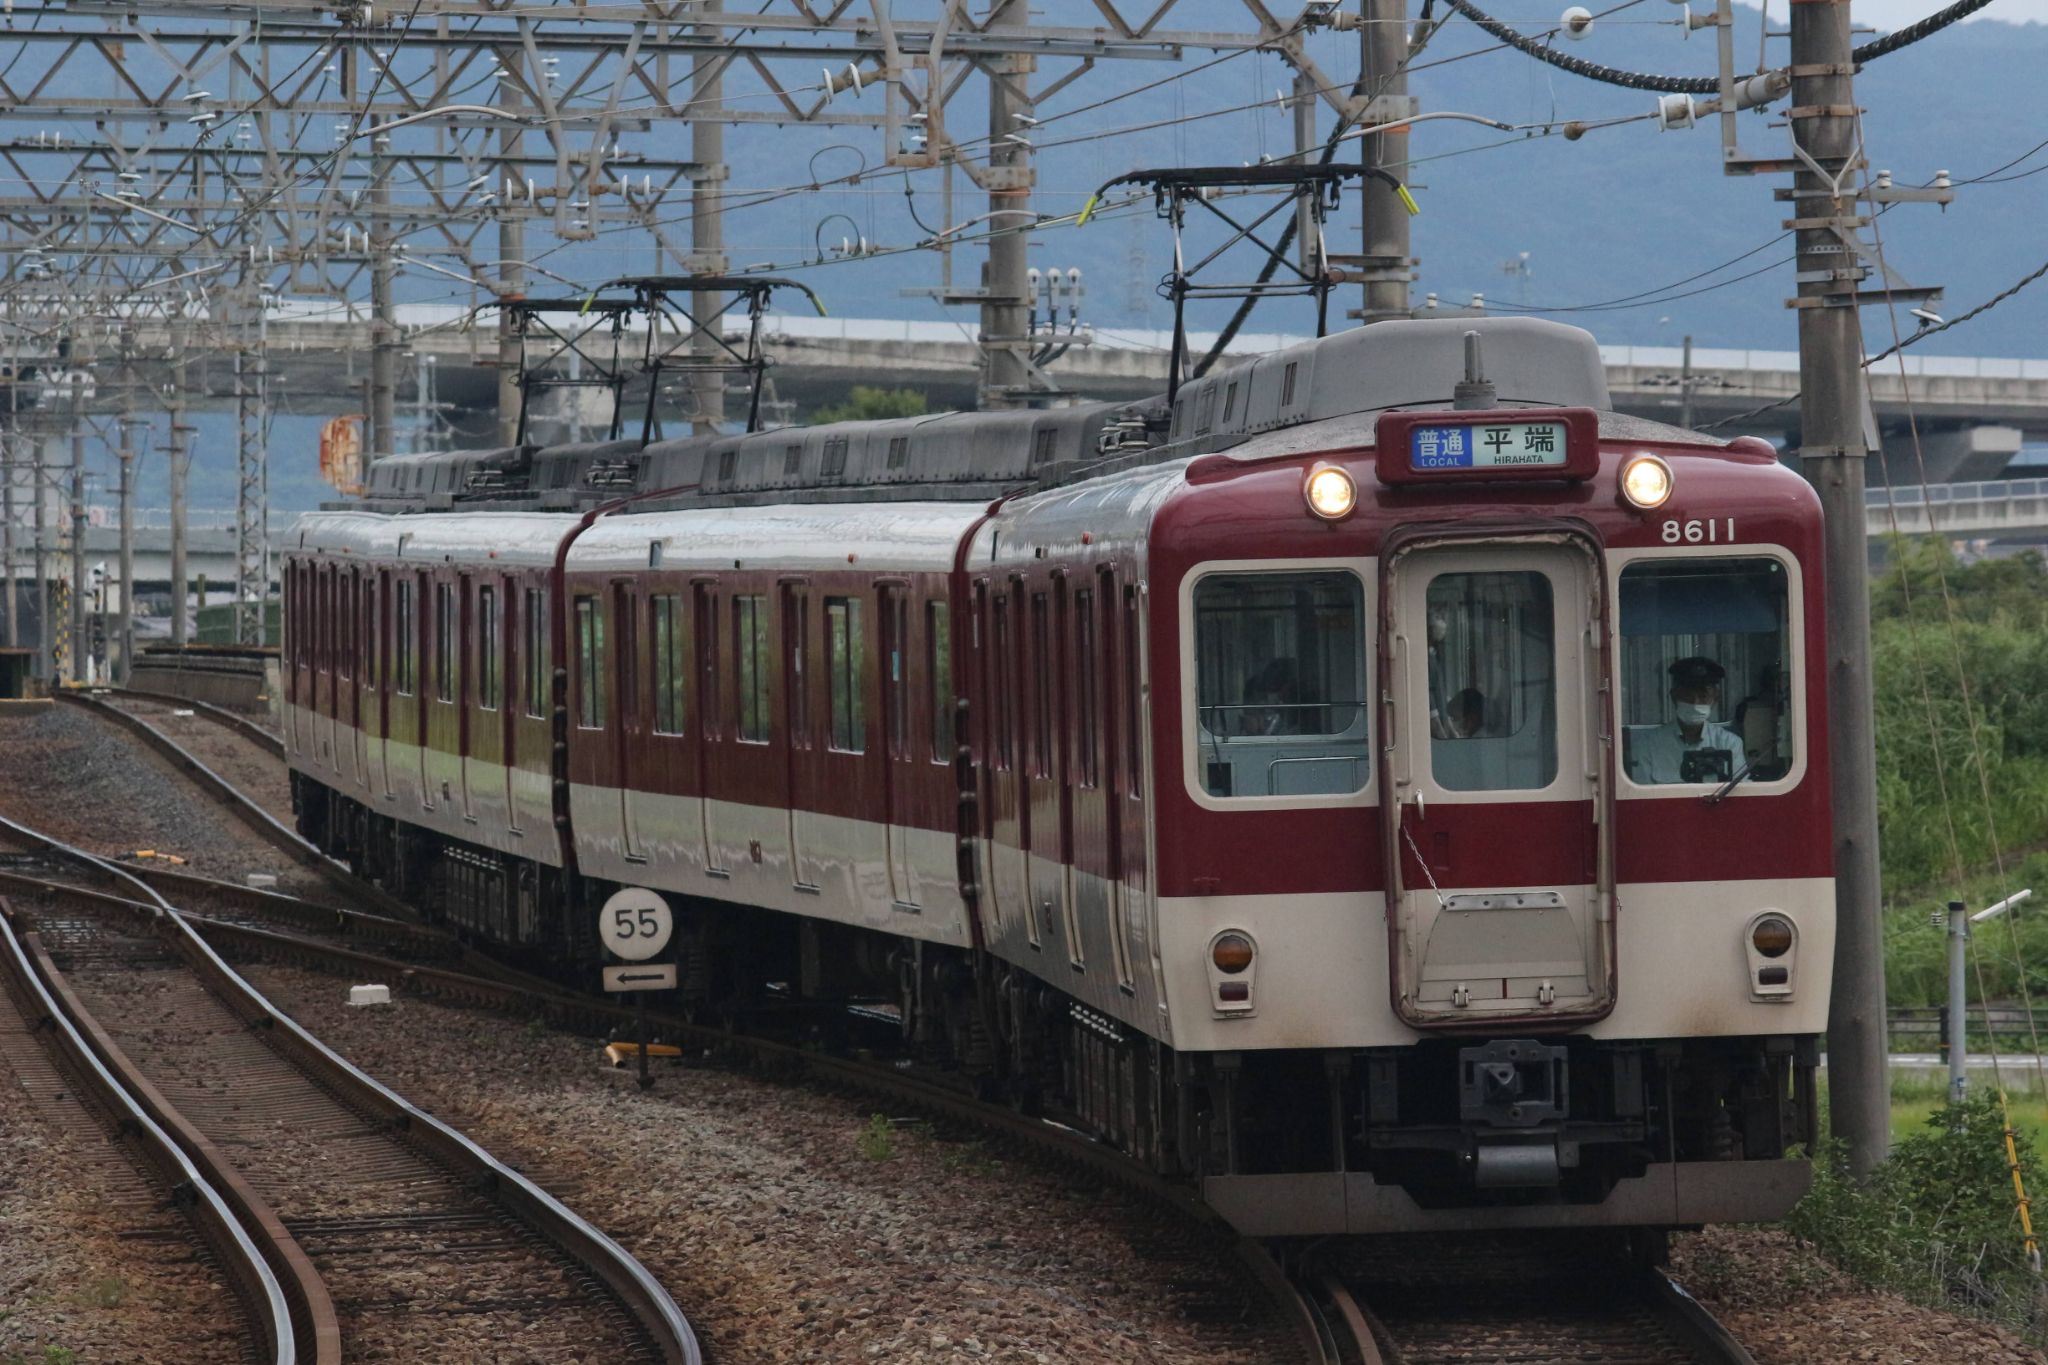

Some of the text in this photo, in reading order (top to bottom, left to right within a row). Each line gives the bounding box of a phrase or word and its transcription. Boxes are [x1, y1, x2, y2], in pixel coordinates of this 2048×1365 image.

[1418, 426, 1555, 457] 普通 平端
[1421, 455, 1544, 467] LOCAL HIRAHATA
[1662, 517, 1735, 543] 8611
[615, 909, 658, 939] 55
